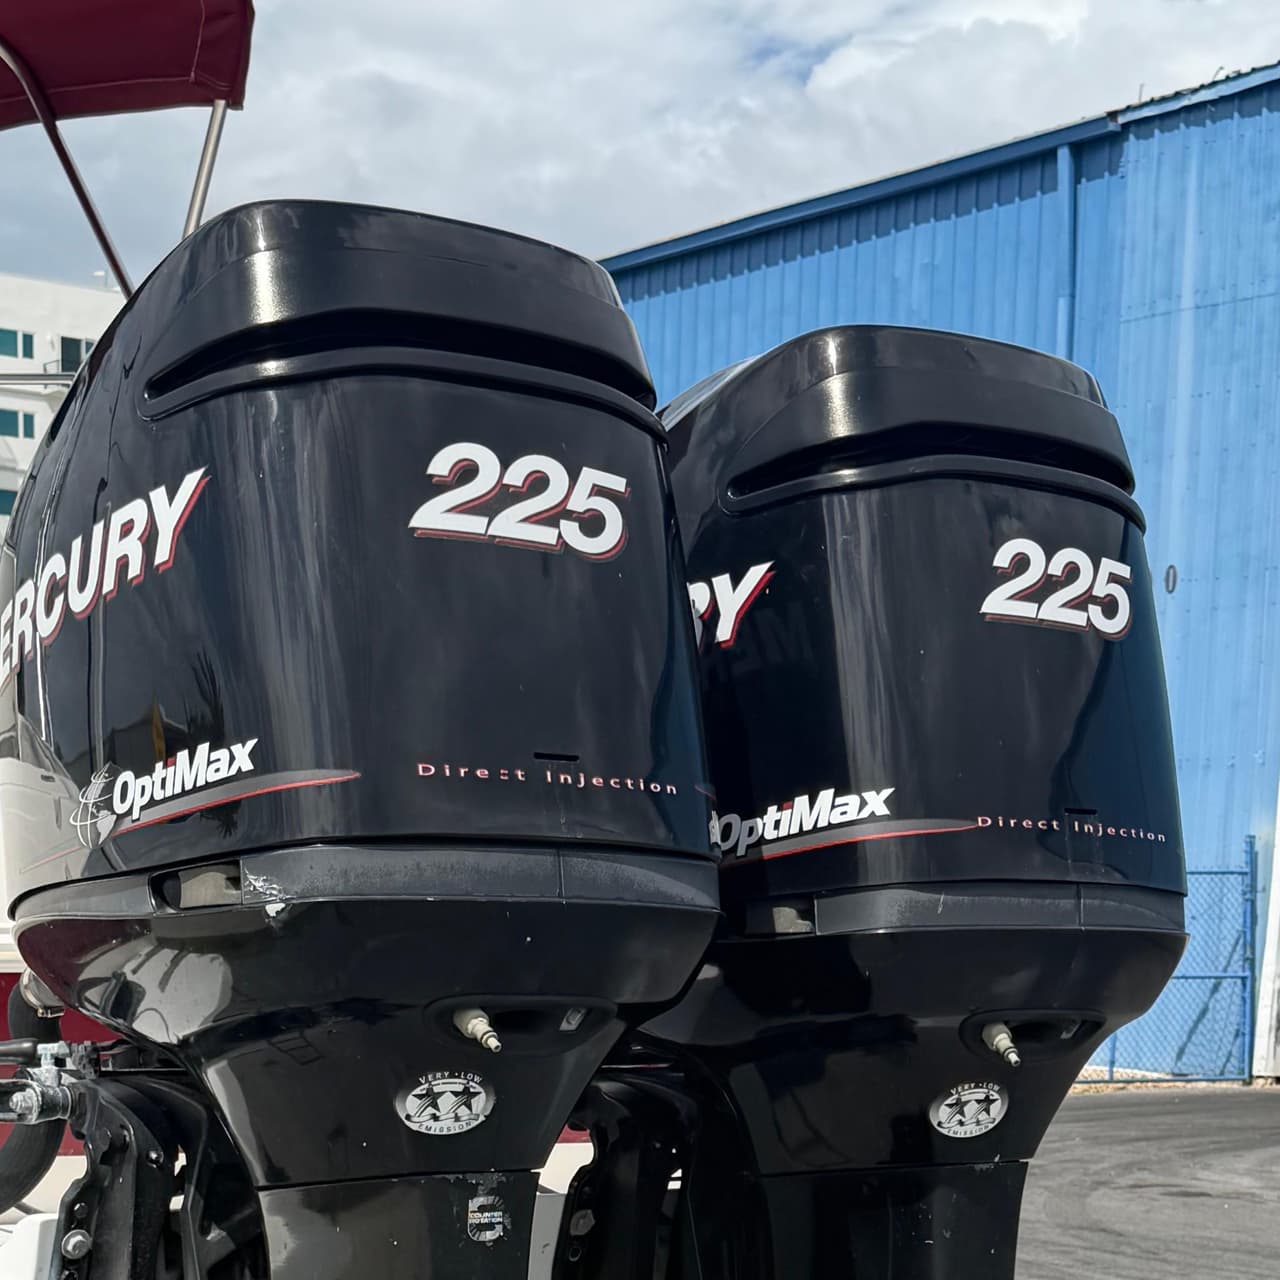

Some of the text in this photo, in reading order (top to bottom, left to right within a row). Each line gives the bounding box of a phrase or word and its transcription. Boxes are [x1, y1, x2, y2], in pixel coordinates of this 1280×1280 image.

[408, 441, 631, 560] 225
[980, 537, 1133, 639] 225
[113, 738, 258, 820] OptiMax
[417, 763, 677, 795] Direct Injection
[718, 787, 895, 857] OptiMax
[977, 816, 1166, 843] Direct Injection
[419, 1071, 483, 1084] VERY LOW
